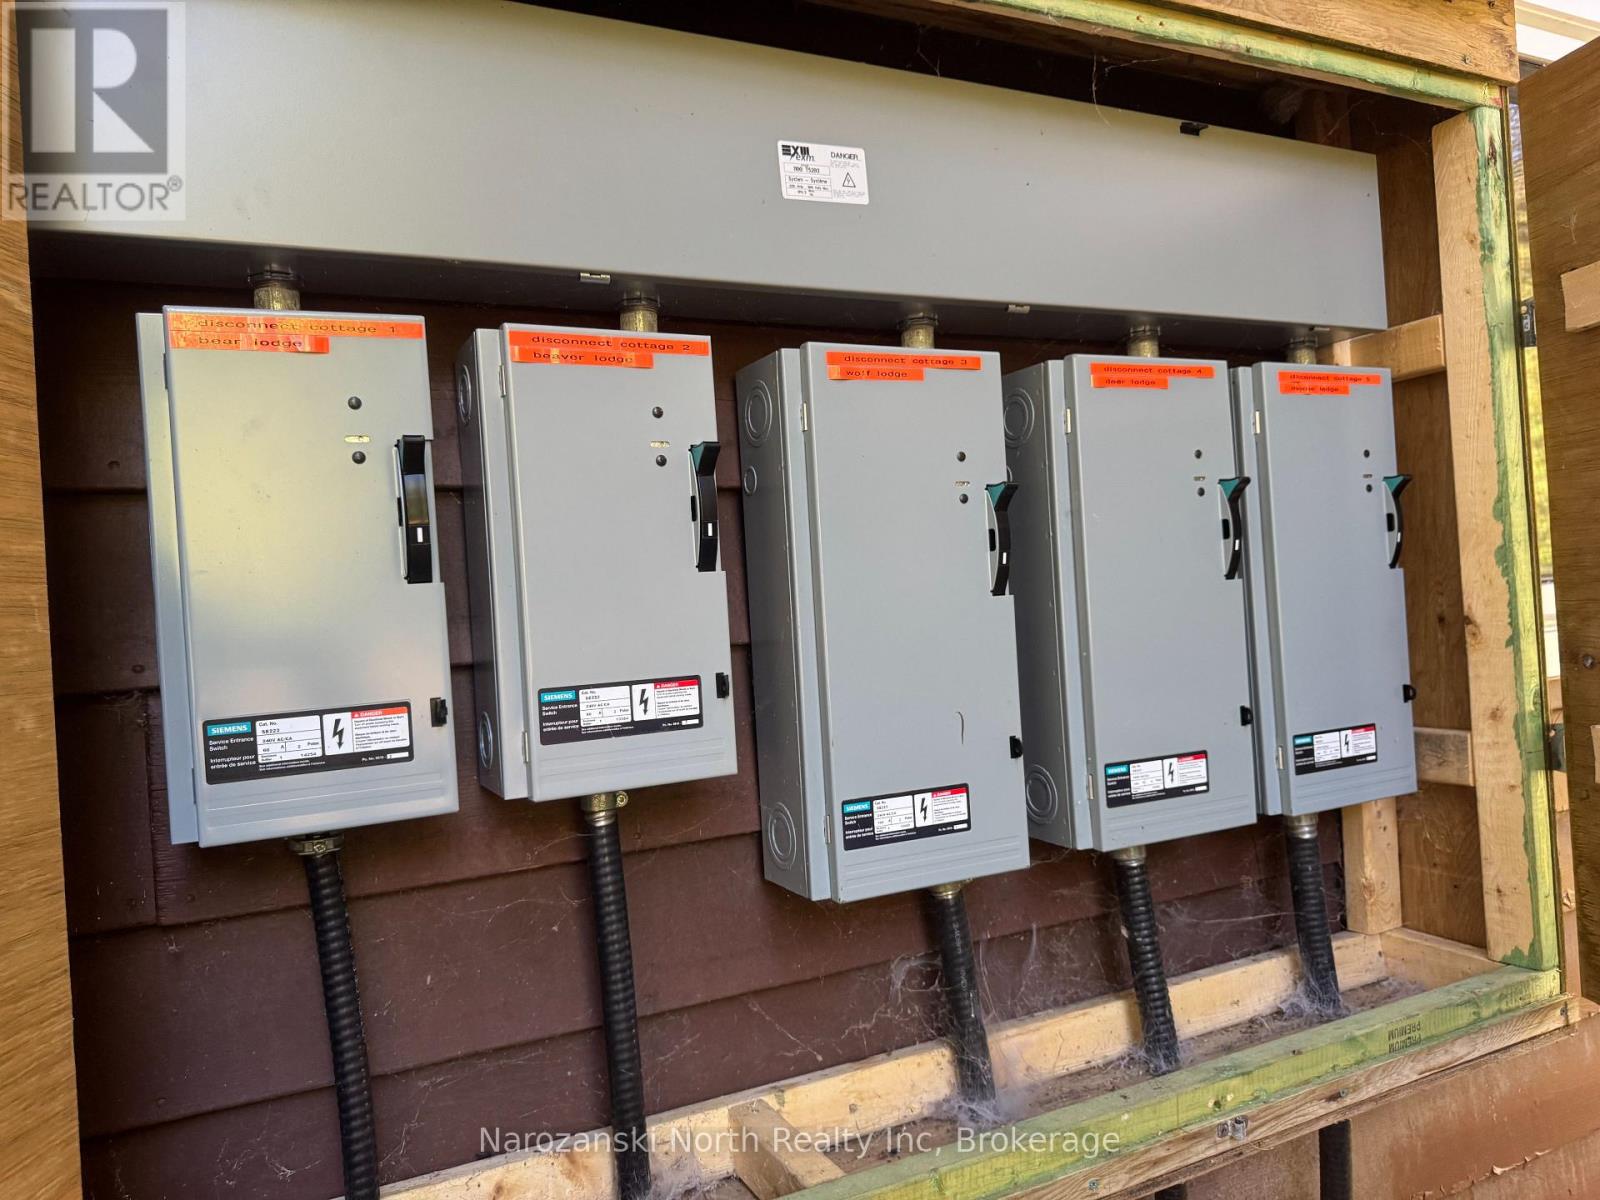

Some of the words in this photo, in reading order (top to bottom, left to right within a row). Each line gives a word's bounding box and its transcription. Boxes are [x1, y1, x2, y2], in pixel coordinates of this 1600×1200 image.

[198, 318, 299, 333] disconnect
[309, 322, 378, 334] cottage
[389, 323, 396, 333] 1
[199, 336, 241, 346] bear
[531, 335, 613, 348] disconnect
[620, 339, 675, 351] cottage
[682, 343, 690, 351] 2
[533, 351, 585, 362] beaver
[594, 353, 634, 365] lodge
[844, 354, 906, 364] disconnect
[912, 357, 955, 366] cottage
[877, 370, 908, 379] lodge
[1103, 366, 1153, 375] disconnect
[1157, 367, 1192, 376] cottage
[544, 693, 573, 701] SIEMENS
[211, 724, 248, 735] SIEMENS
